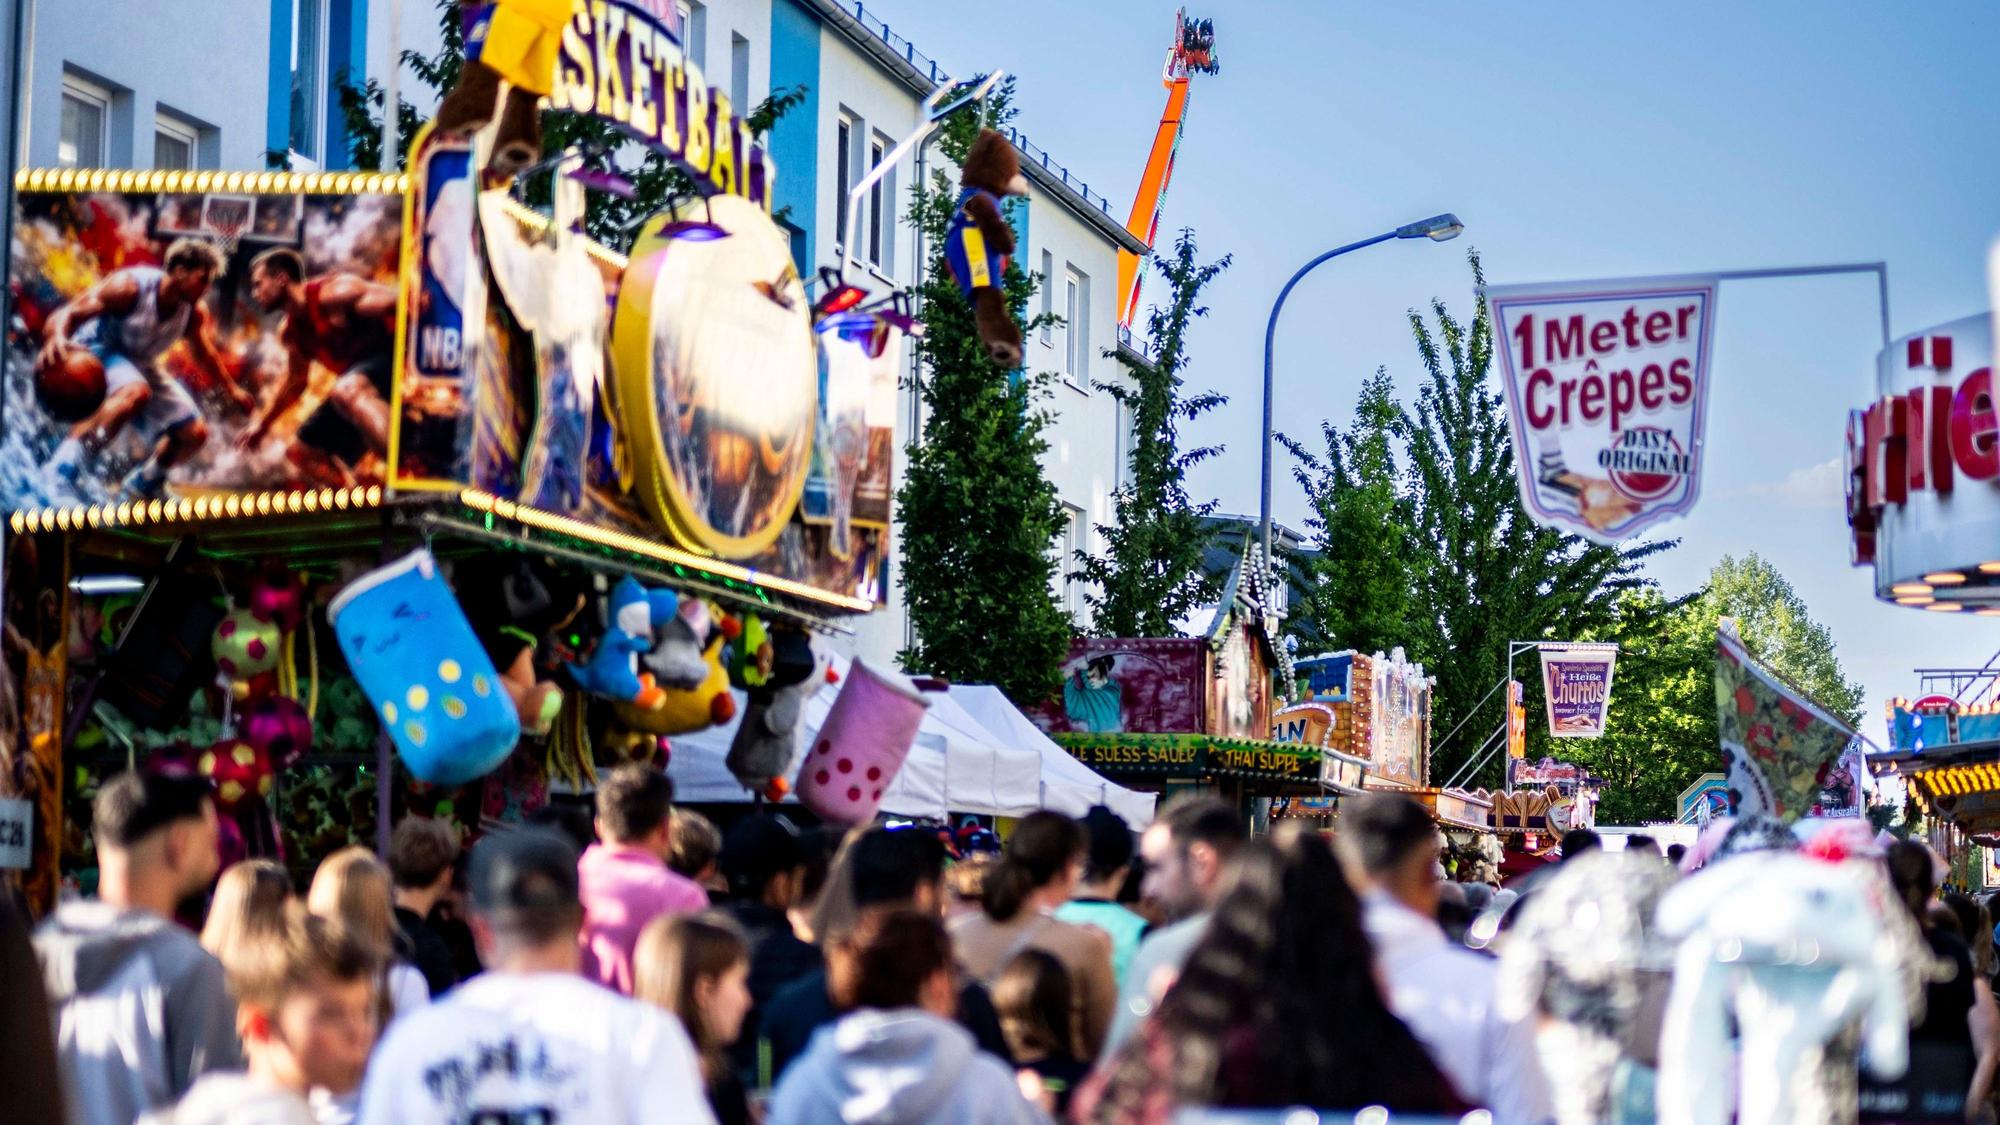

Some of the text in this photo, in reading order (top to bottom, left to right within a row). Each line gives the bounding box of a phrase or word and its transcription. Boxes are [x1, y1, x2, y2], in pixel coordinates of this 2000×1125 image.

[422, 325, 465, 370] NB
[1544, 304, 1697, 363] Meter
[1525, 359, 1694, 432] Crêpes
[1597, 448, 1694, 475] ORIGINAL
[1549, 663, 1605, 704] Churros
[1569, 672, 1602, 681] Heiße
[1094, 744, 1197, 764] SUESS-SAUER
[1225, 750, 1256, 768] THAI
[1259, 751, 1301, 772] SUPPE
